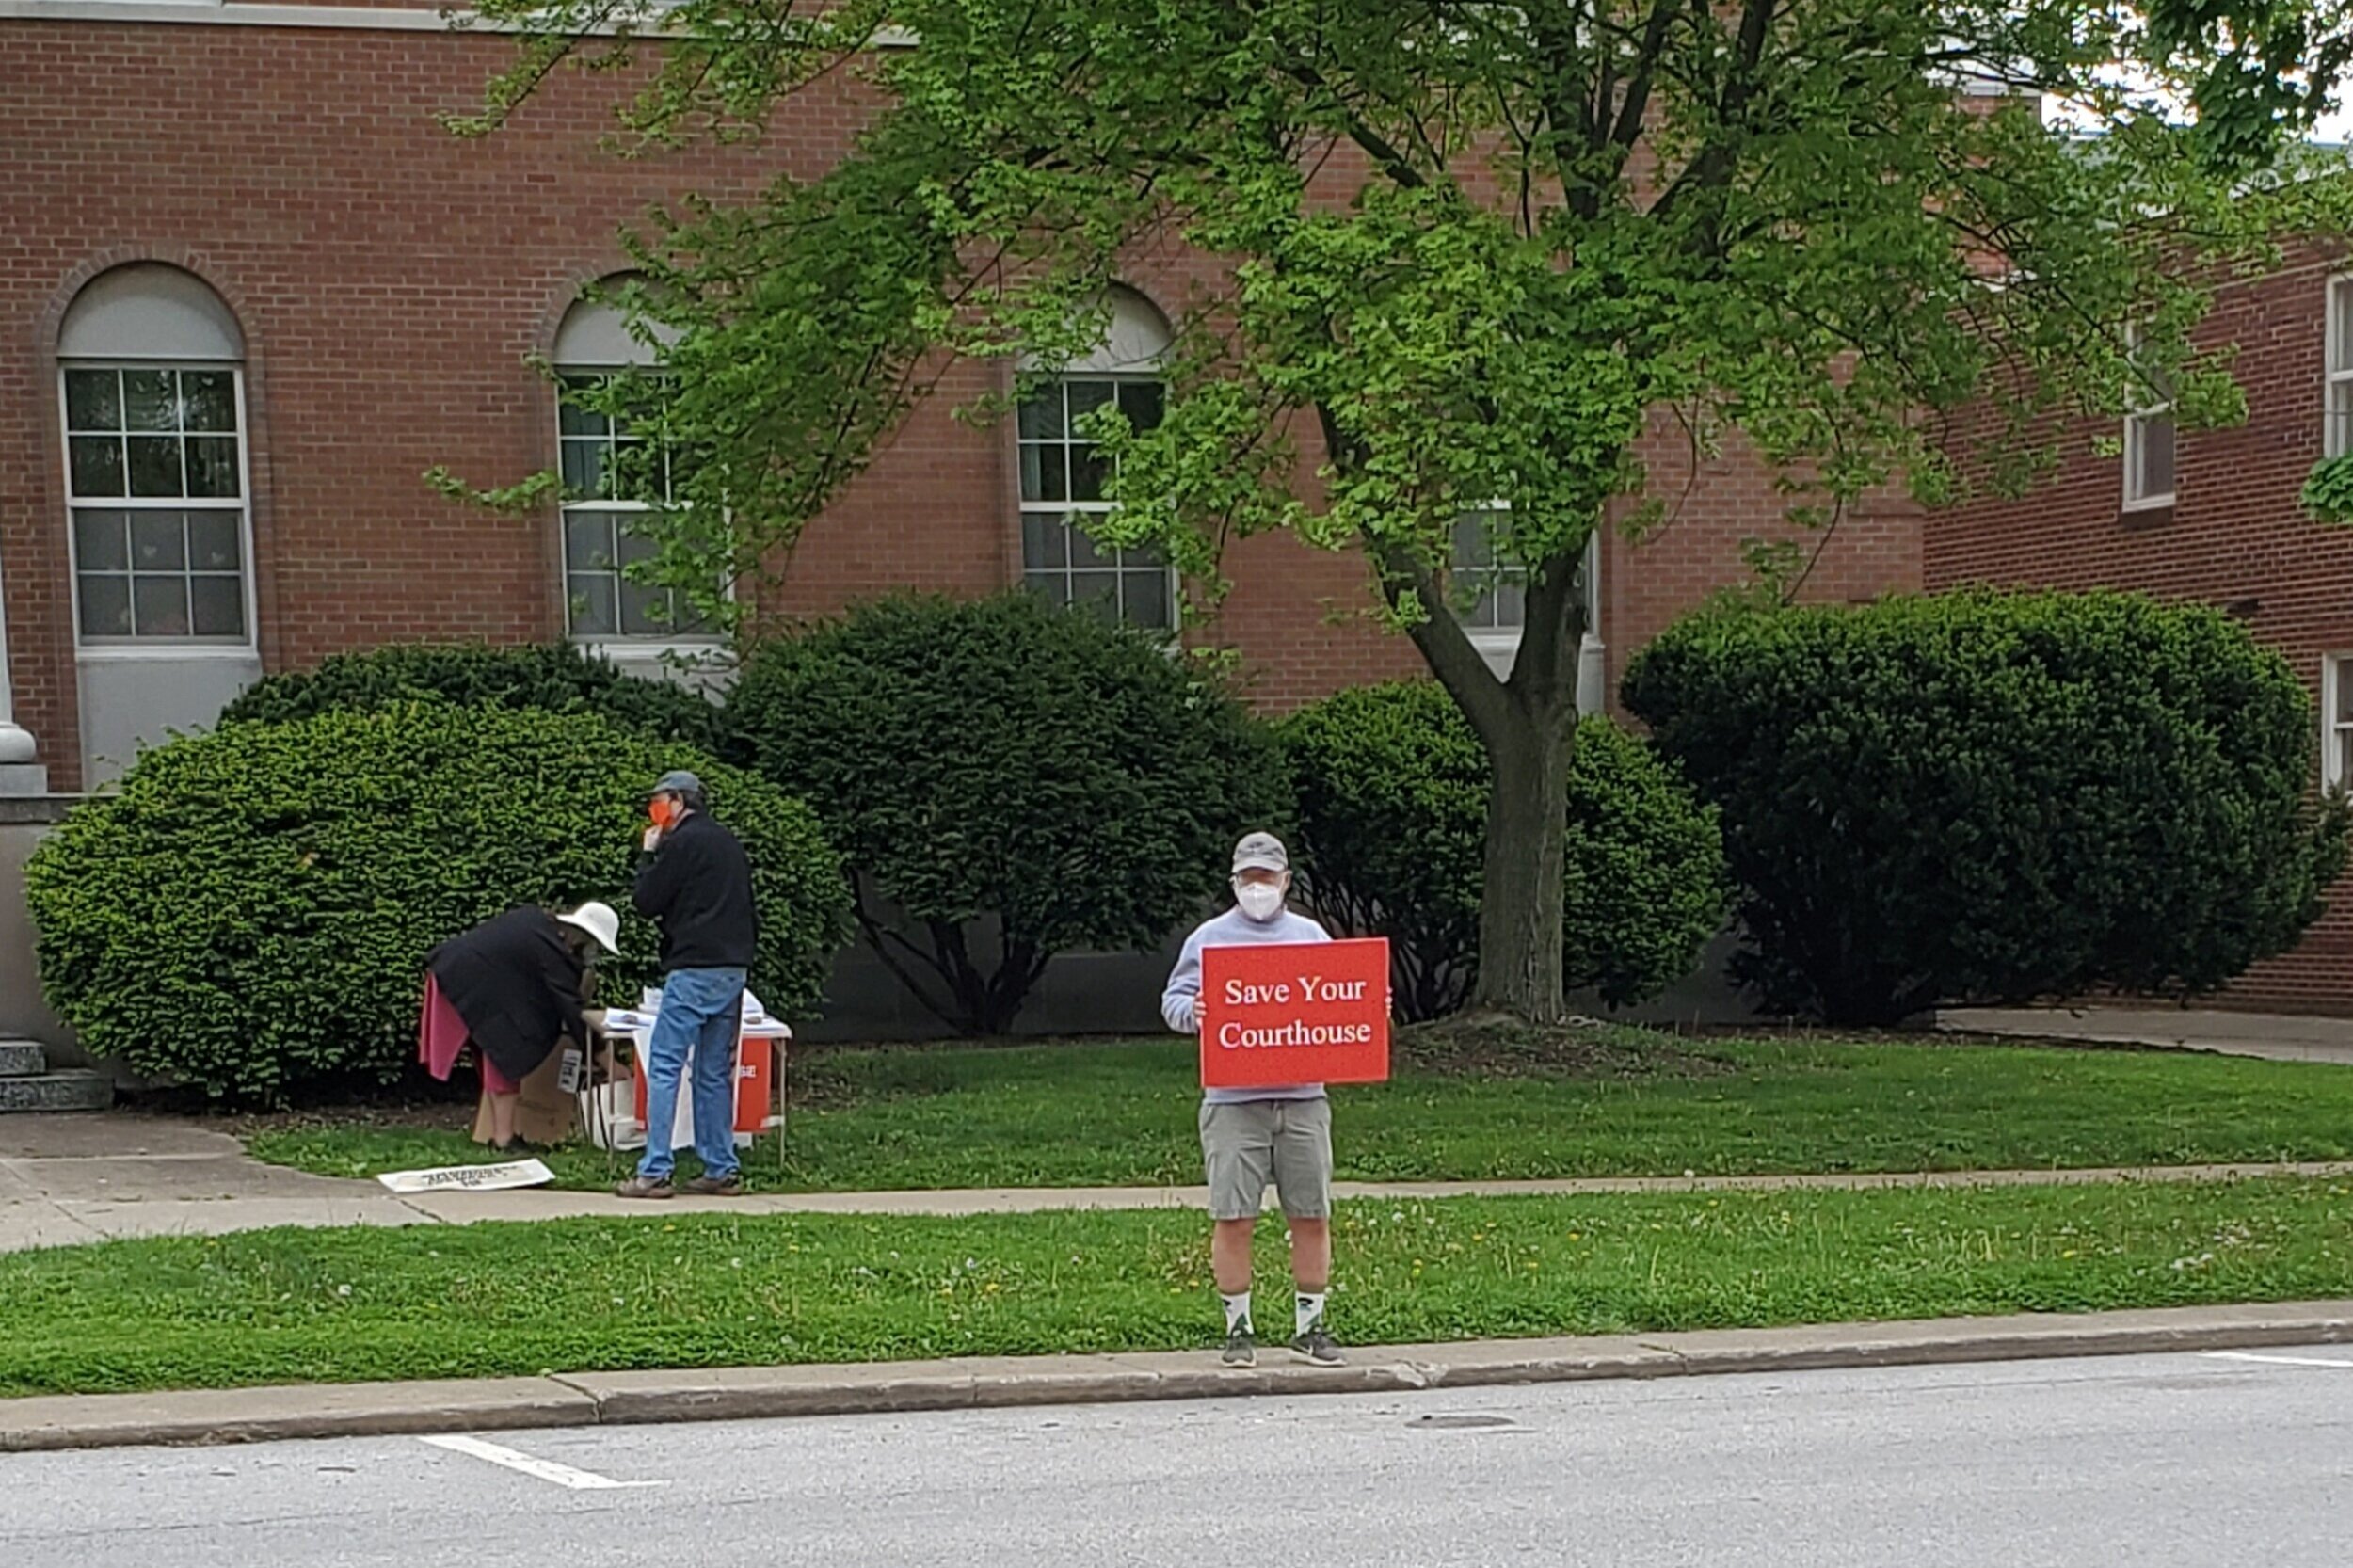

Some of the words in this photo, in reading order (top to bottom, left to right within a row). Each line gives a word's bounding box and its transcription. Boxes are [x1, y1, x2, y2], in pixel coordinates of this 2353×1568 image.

[1225, 979, 1290, 1005] Save
[1298, 976, 1367, 1001] Your
[1219, 1019, 1371, 1048] Courthouse
